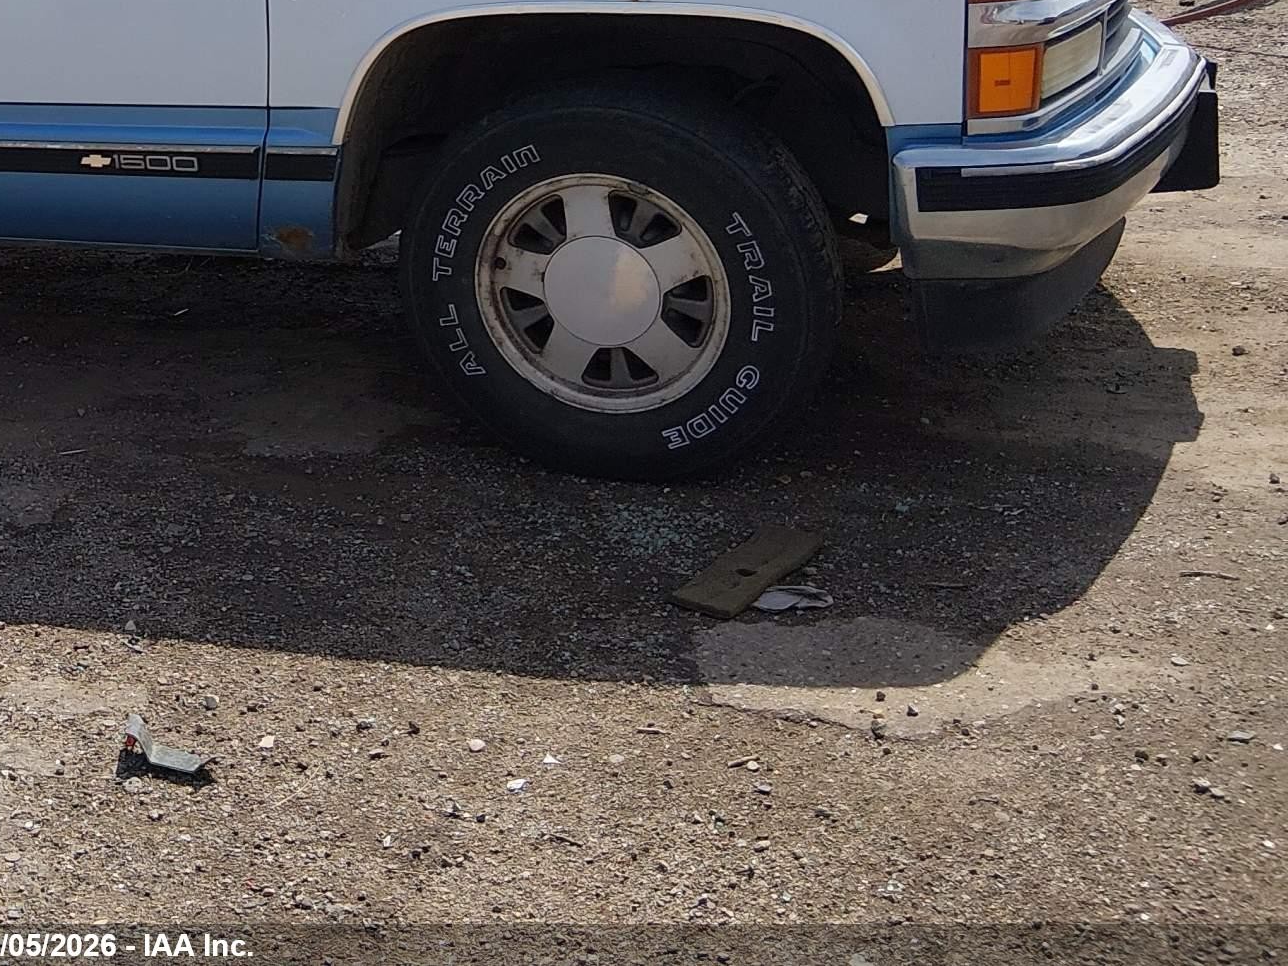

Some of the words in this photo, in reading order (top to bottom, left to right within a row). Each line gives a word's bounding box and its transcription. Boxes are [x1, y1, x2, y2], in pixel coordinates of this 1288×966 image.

[113, 154, 199, 172] 1500
[433, 144, 542, 281] TERRAIN
[724, 212, 775, 342] TRAIL
[440, 303, 487, 376] ALL
[661, 365, 761, 450] GUIDE
